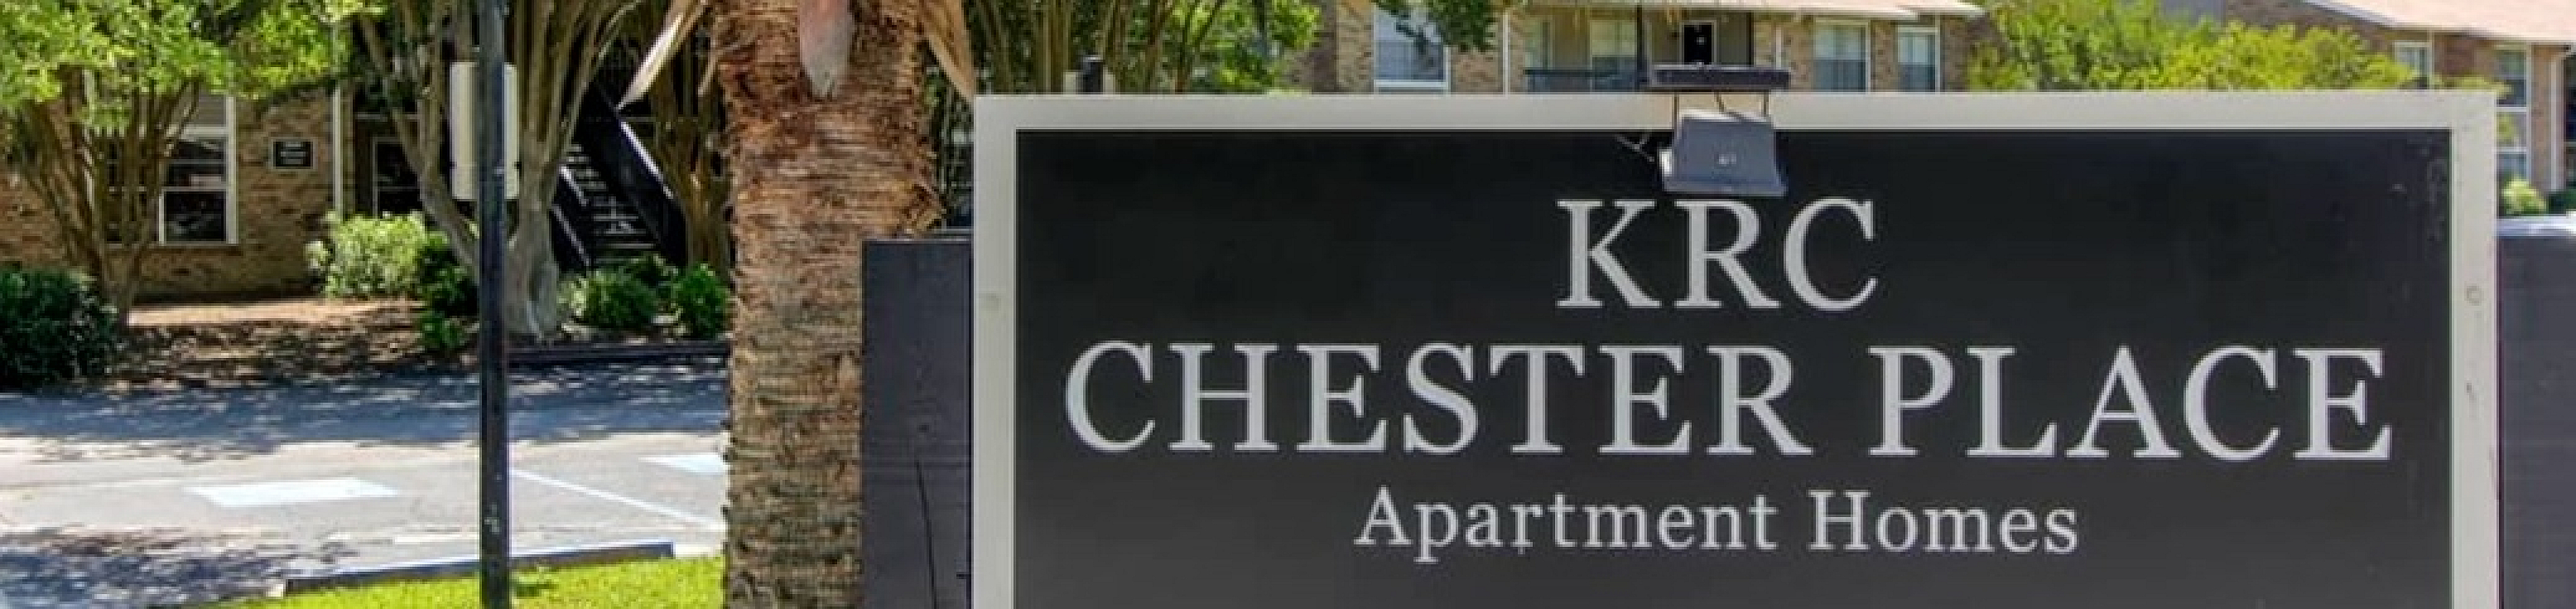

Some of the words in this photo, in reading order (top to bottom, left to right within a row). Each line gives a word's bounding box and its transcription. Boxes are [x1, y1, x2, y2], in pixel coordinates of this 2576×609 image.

[1556, 198, 1877, 310] KRC
[1066, 342, 1813, 457] CHESTER
[1869, 346, 2392, 461] PLACE
[1355, 486, 1780, 563] Apartment
[1809, 491, 2079, 553] Homes
